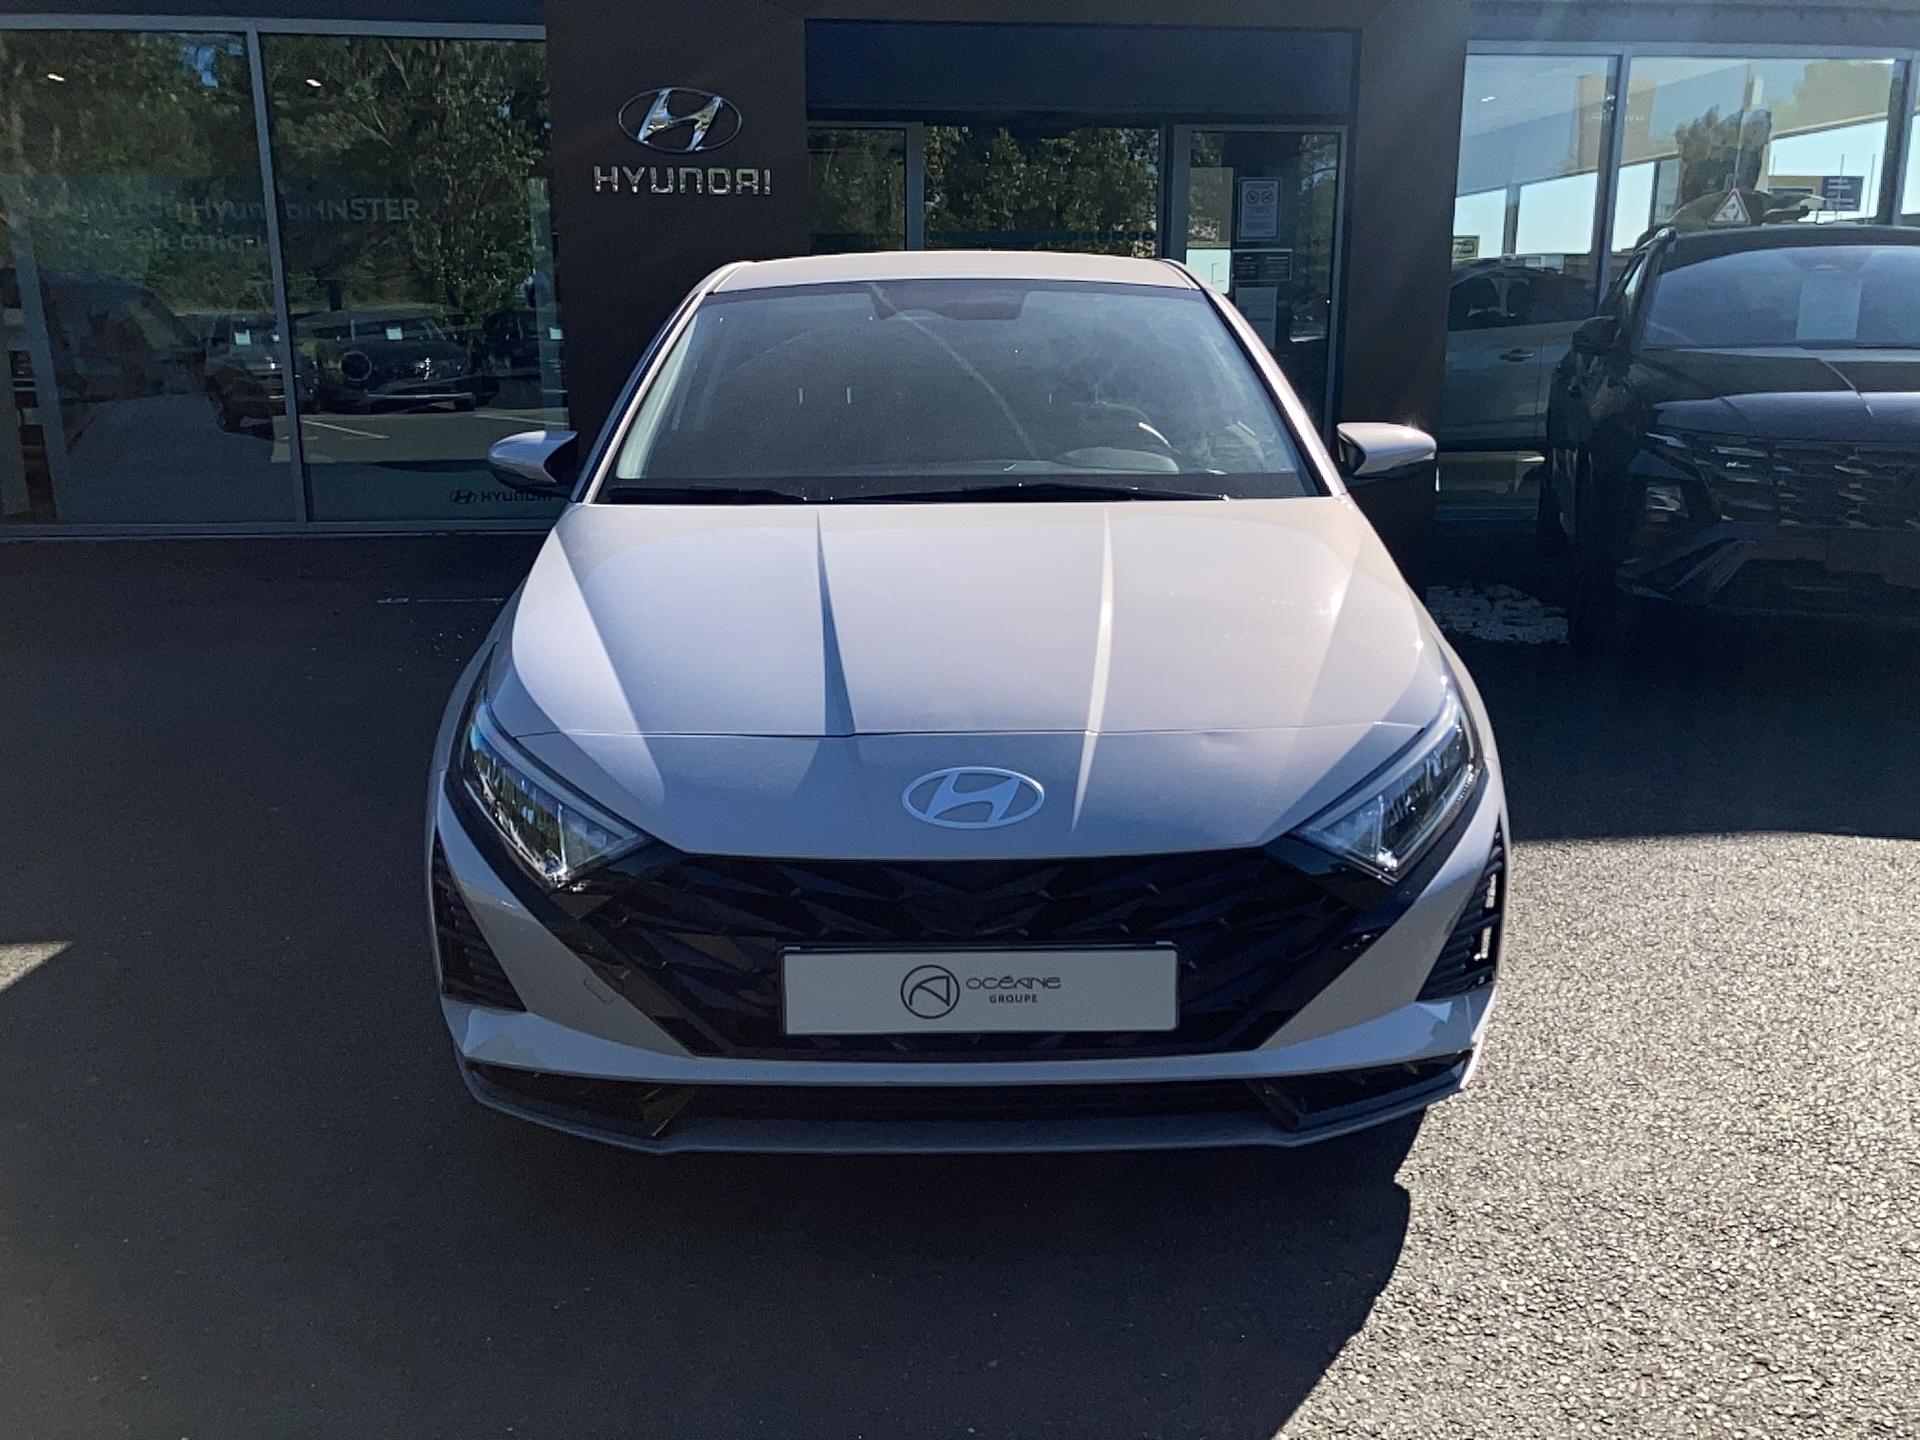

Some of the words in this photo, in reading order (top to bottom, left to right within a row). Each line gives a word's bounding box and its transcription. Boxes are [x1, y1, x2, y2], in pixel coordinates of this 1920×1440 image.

[593, 165, 772, 196] HYUNDAI
[319, 198, 421, 222] INSTER
[965, 974, 1062, 990] OCÉANE
[988, 993, 1038, 1004] GROUPE
